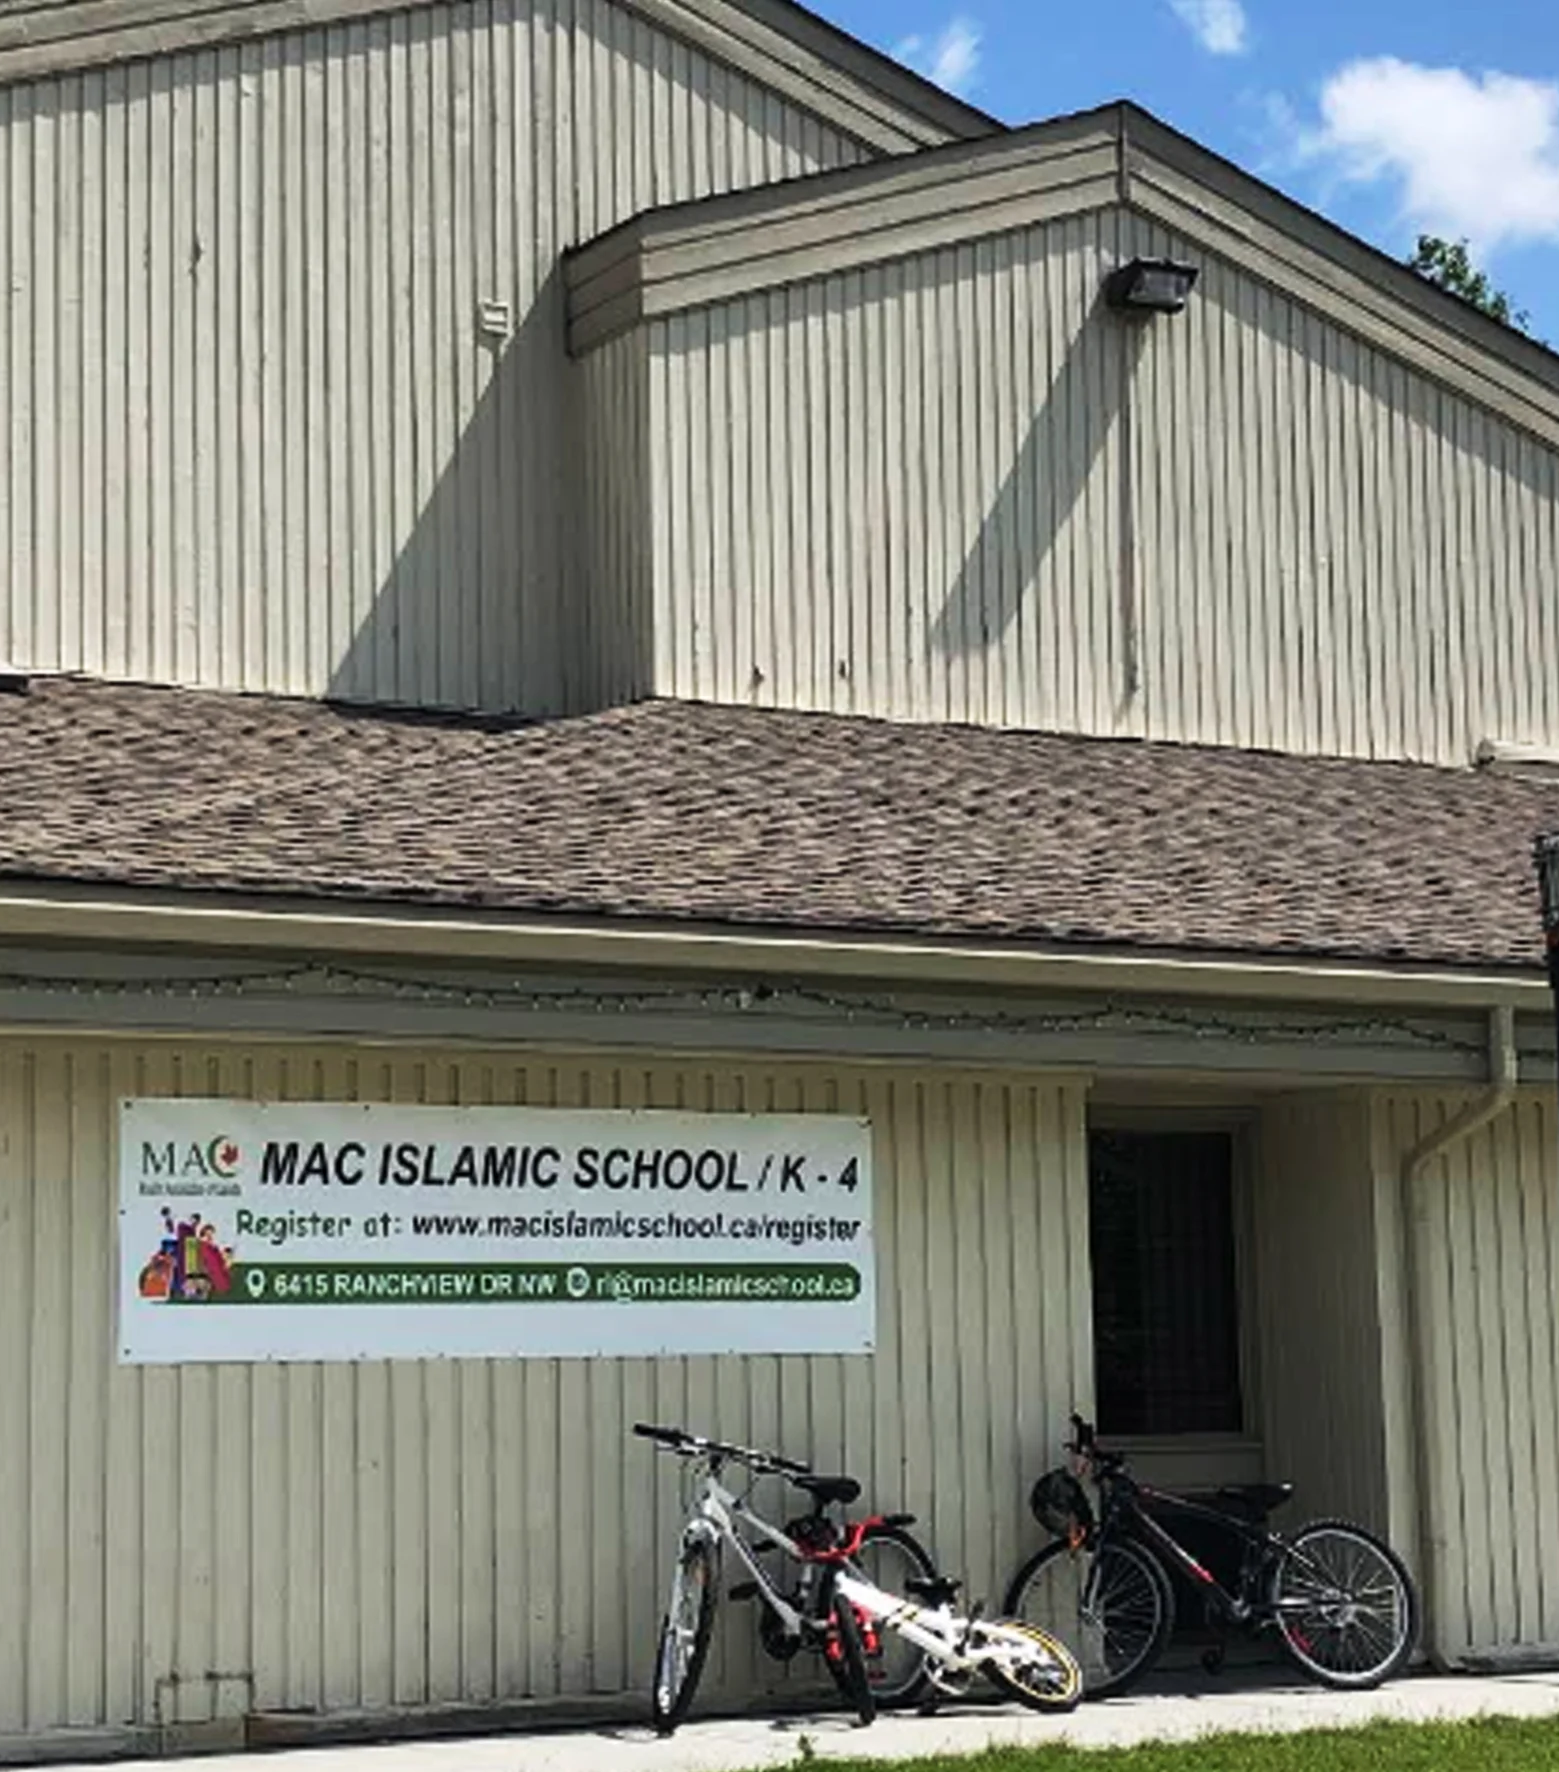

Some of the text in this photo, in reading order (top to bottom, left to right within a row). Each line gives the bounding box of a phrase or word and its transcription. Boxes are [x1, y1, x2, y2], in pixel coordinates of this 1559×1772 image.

[141, 1135, 239, 1179] MAC
[260, 1142, 366, 1186] MAC
[378, 1143, 561, 1188] ISLAMIC
[573, 1147, 749, 1191] SCHOOL
[780, 1154, 806, 1192] K
[838, 1156, 858, 1192] 4
[236, 1208, 352, 1244] Register
[363, 1212, 403, 1238] at:
[272, 1272, 329, 1296] 6415
[333, 1272, 474, 1296] RANCHVIEW
[480, 1272, 512, 1296] DR
[517, 1272, 558, 1296] NW
